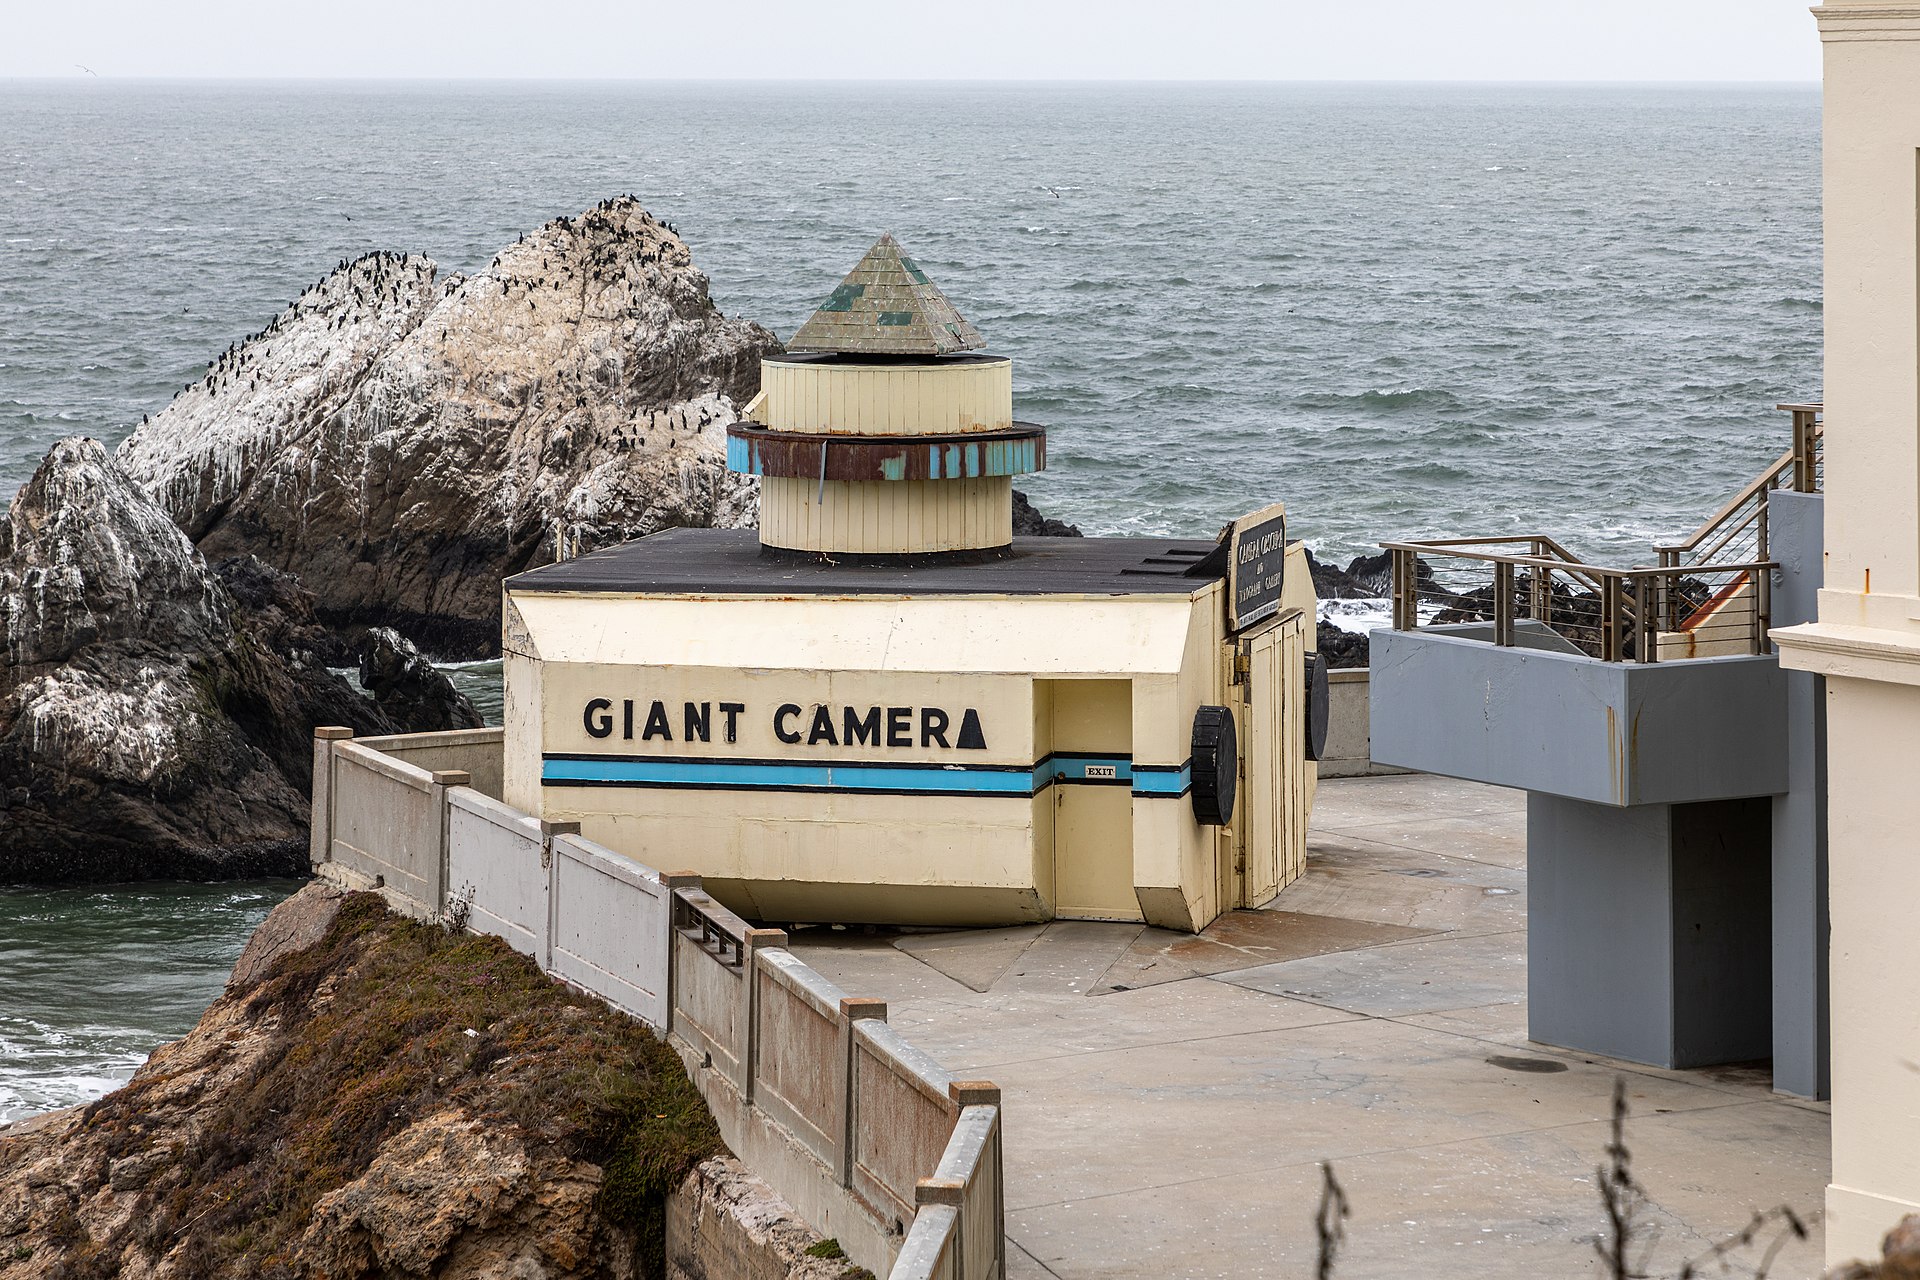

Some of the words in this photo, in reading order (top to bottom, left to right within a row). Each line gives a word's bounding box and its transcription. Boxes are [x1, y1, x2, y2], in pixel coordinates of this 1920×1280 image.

[583, 697, 745, 743] GIANT
[773, 703, 987, 749] CAMERA
[1087, 767, 1114, 776] EXIT
